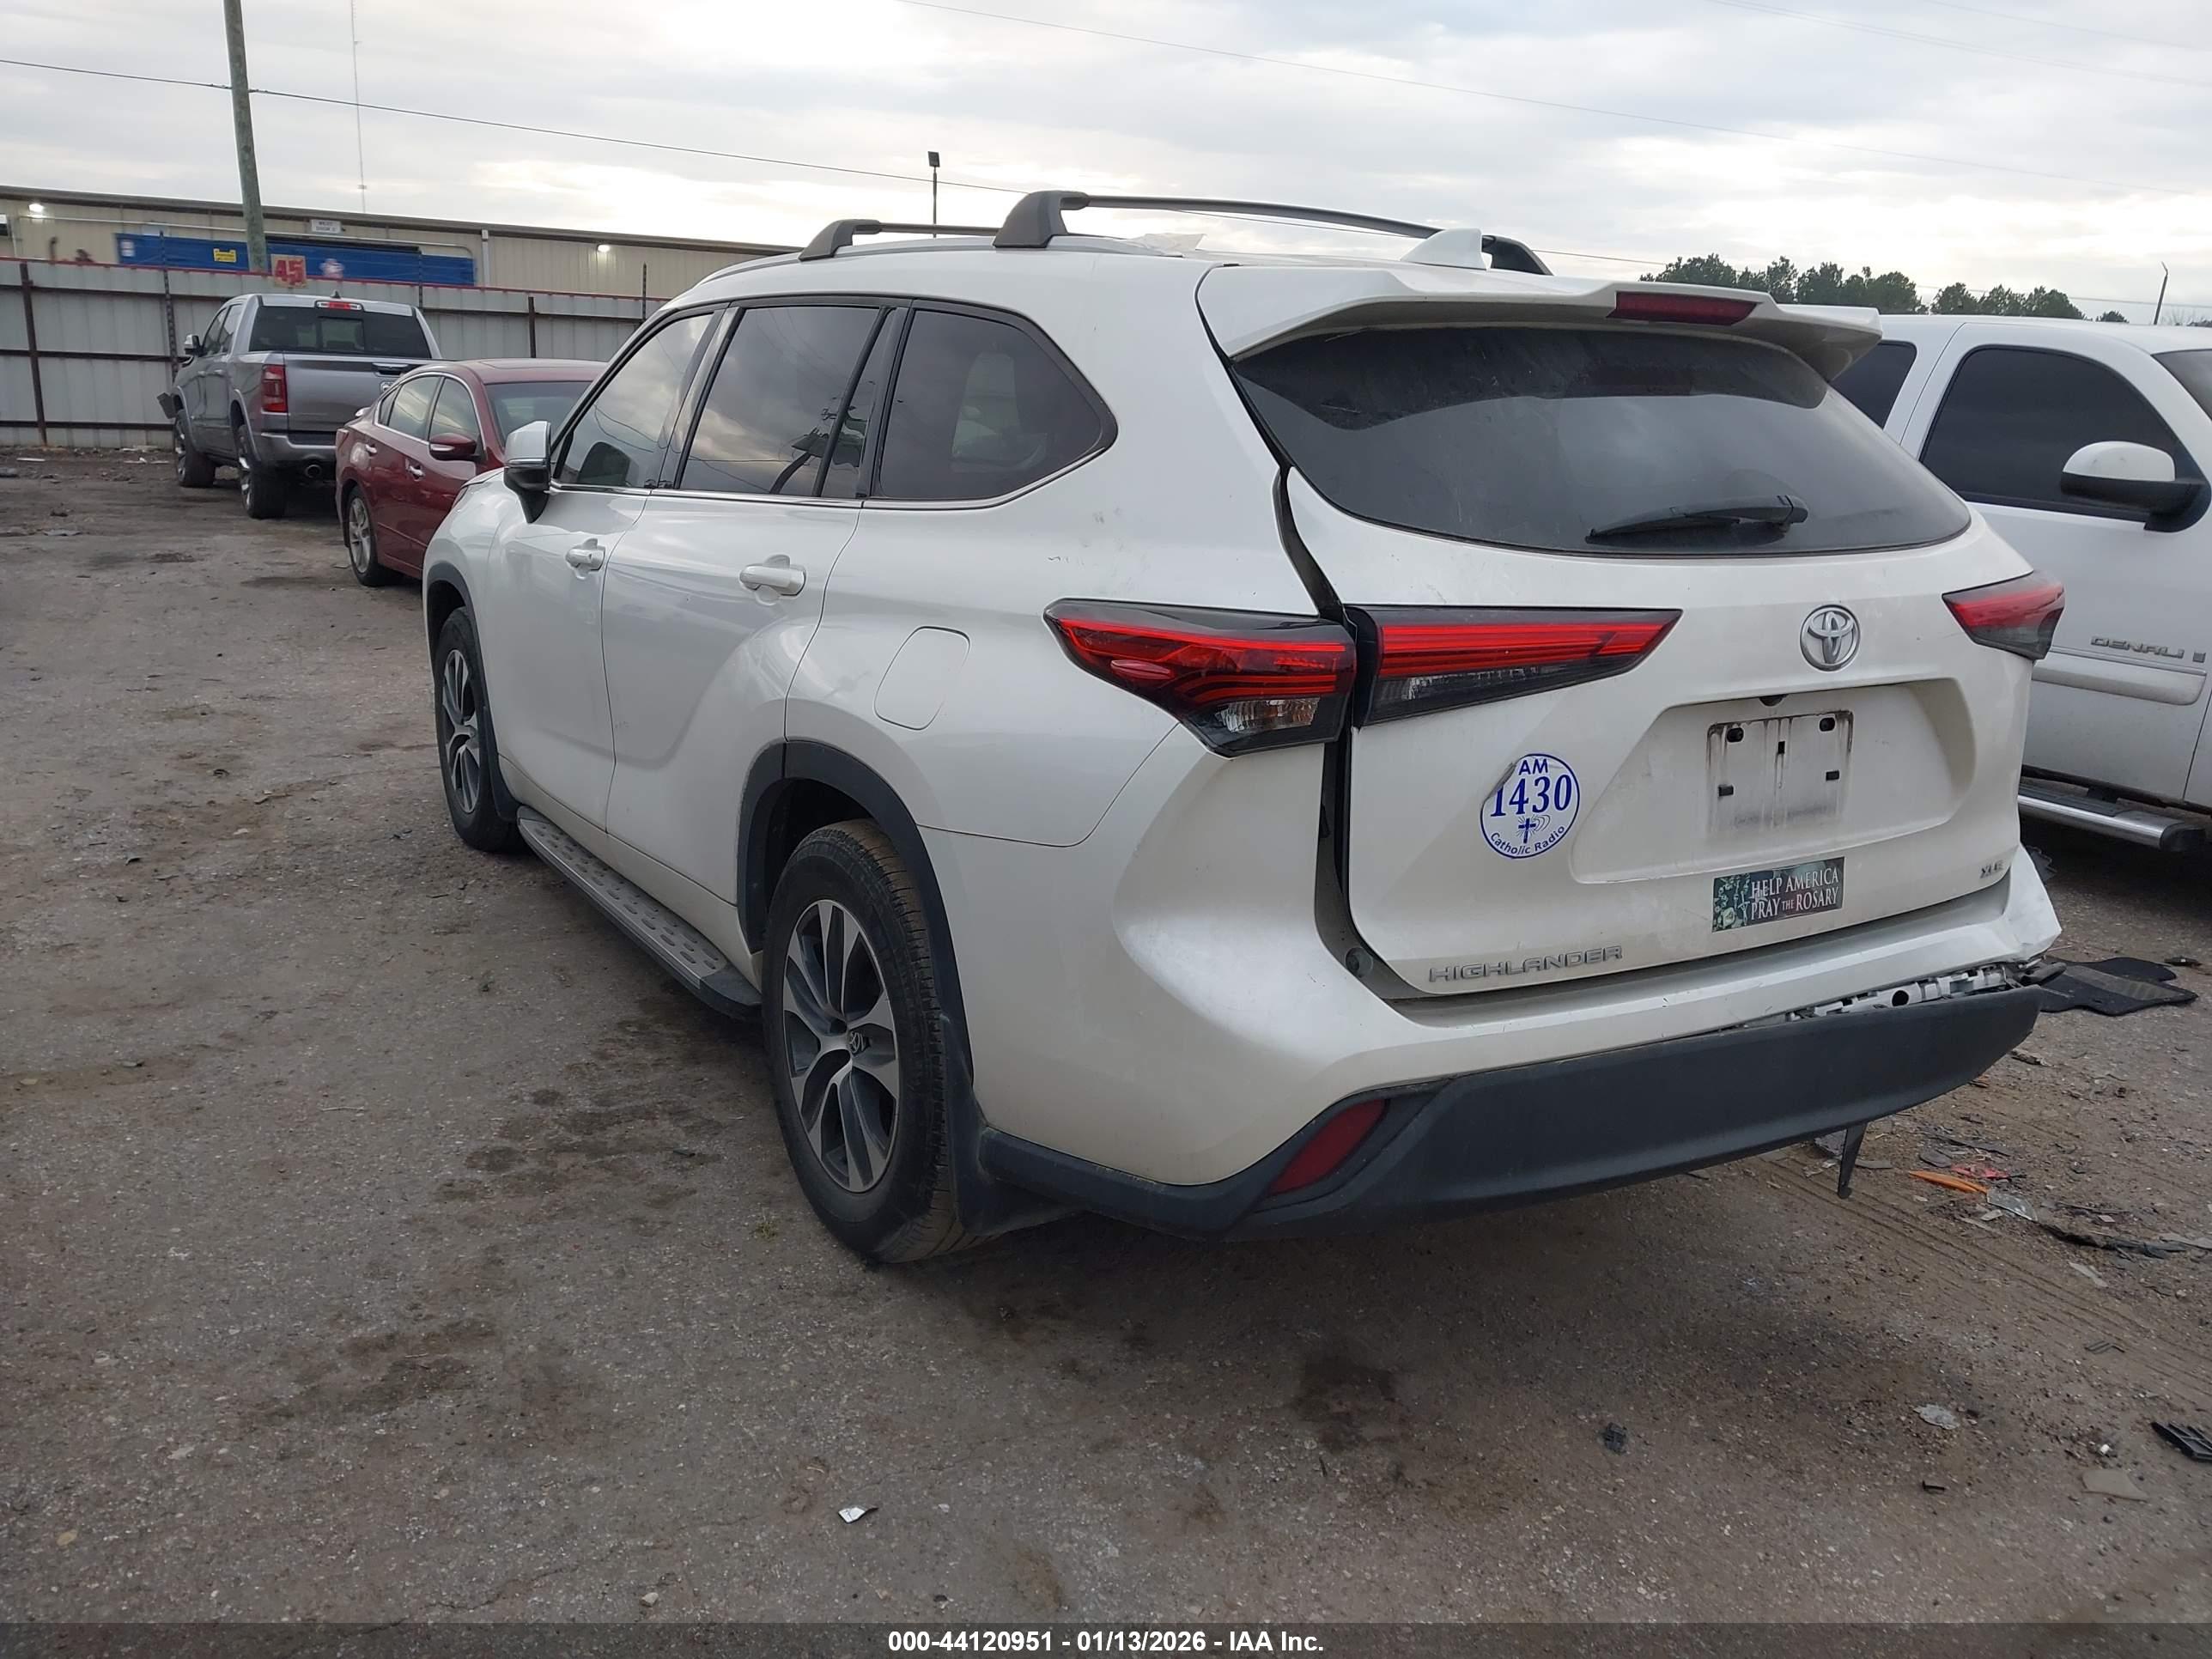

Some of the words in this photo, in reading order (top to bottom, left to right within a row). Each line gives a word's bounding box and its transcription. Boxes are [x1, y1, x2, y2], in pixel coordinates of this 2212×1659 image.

[274, 259, 304, 285] 45
[2090, 635, 2185, 659] DENALI
[1518, 758, 1549, 775] AM
[1490, 774, 1573, 817] 1430
[1490, 831, 1532, 856] Catholic
[1534, 825, 1565, 852] Radio
[1750, 877, 1784, 899] HELP
[1785, 866, 1839, 893] AMERICA
[1750, 896, 1782, 921] PRAY
[1782, 899, 1795, 911] THE
[1796, 886, 1839, 912] ROSARY
[1428, 945, 1624, 983] HIGHLANDER
